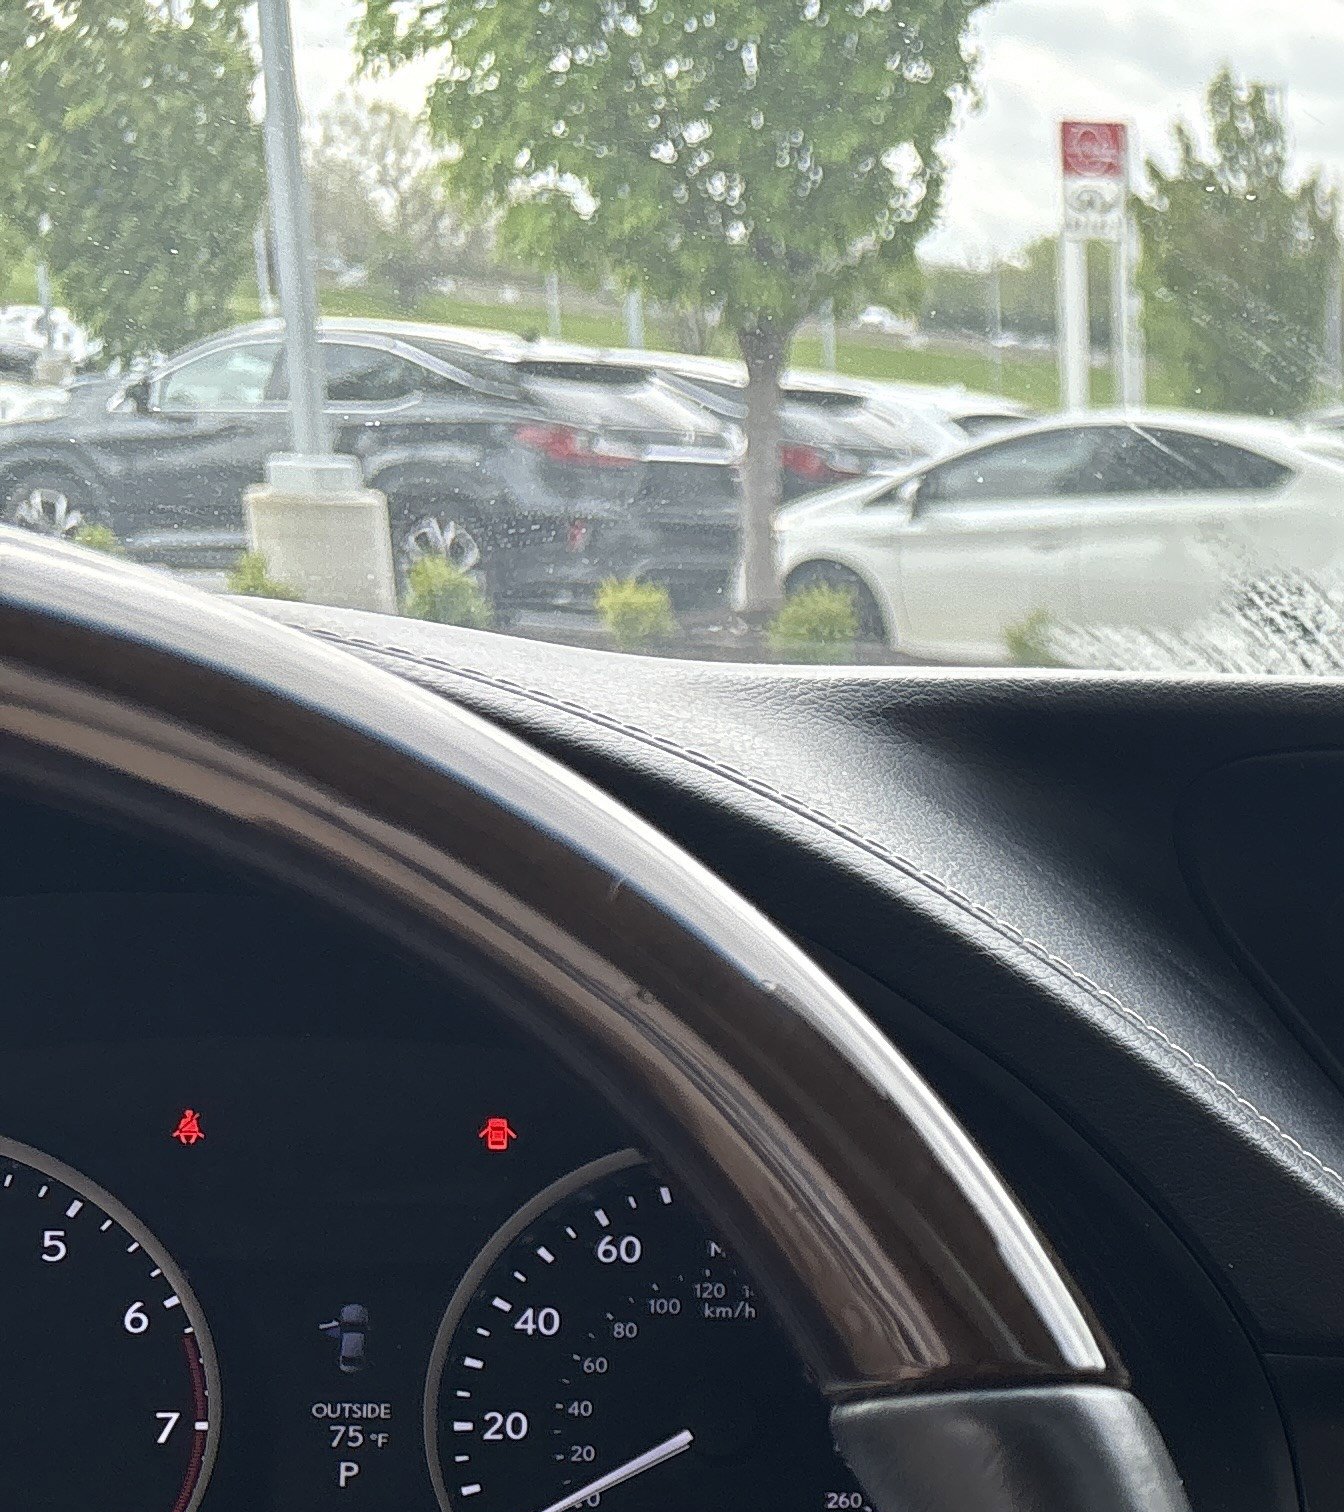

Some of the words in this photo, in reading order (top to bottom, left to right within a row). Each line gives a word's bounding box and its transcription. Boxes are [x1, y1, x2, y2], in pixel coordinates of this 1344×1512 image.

[41, 1230, 67, 1262] 5
[597, 1235, 642, 1264] 60
[694, 1283, 726, 1299] 120
[649, 1298, 681, 1315] 100
[704, 1301, 756, 1319] km/h
[124, 1301, 149, 1334] 6
[514, 1306, 561, 1337] 40
[613, 1322, 638, 1339] 80
[583, 1357, 608, 1374] 60
[311, 1403, 392, 1419] OUTSIDE
[568, 1400, 593, 1417] 40
[155, 1412, 180, 1444] 7
[483, 1411, 528, 1440] 20
[329, 1425, 364, 1448] 75
[570, 1445, 595, 1462] 20
[339, 1461, 360, 1487] P
[826, 1492, 863, 1509] 260
